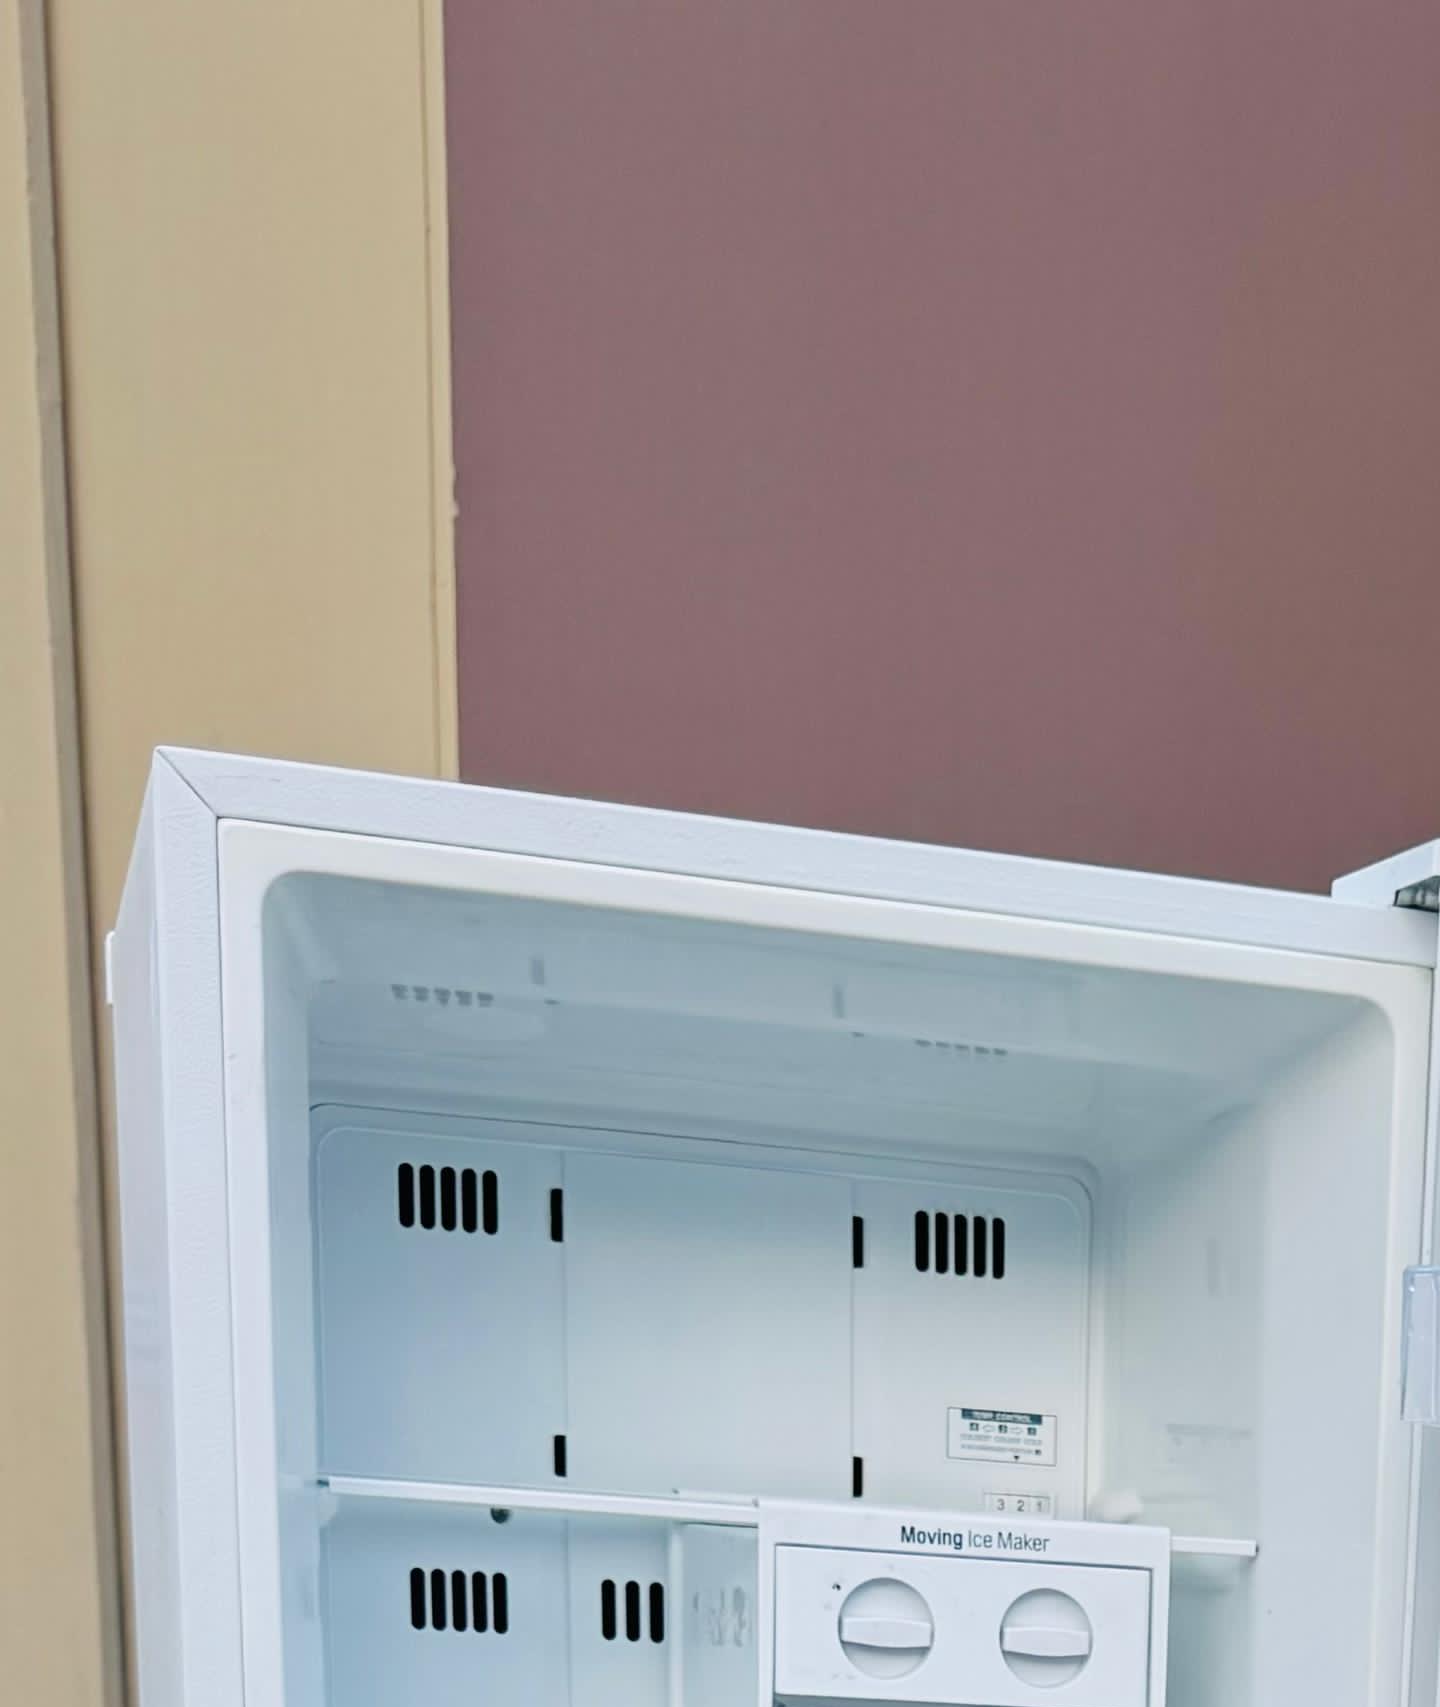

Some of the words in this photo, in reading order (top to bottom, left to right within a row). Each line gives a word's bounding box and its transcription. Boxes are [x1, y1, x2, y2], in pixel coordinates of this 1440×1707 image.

[997, 1499, 1005, 1511] 3
[1017, 1500, 1025, 1512] 2
[900, 1525, 963, 1550] Moving
[968, 1530, 993, 1548] Ice
[997, 1532, 1050, 1552] Maker
